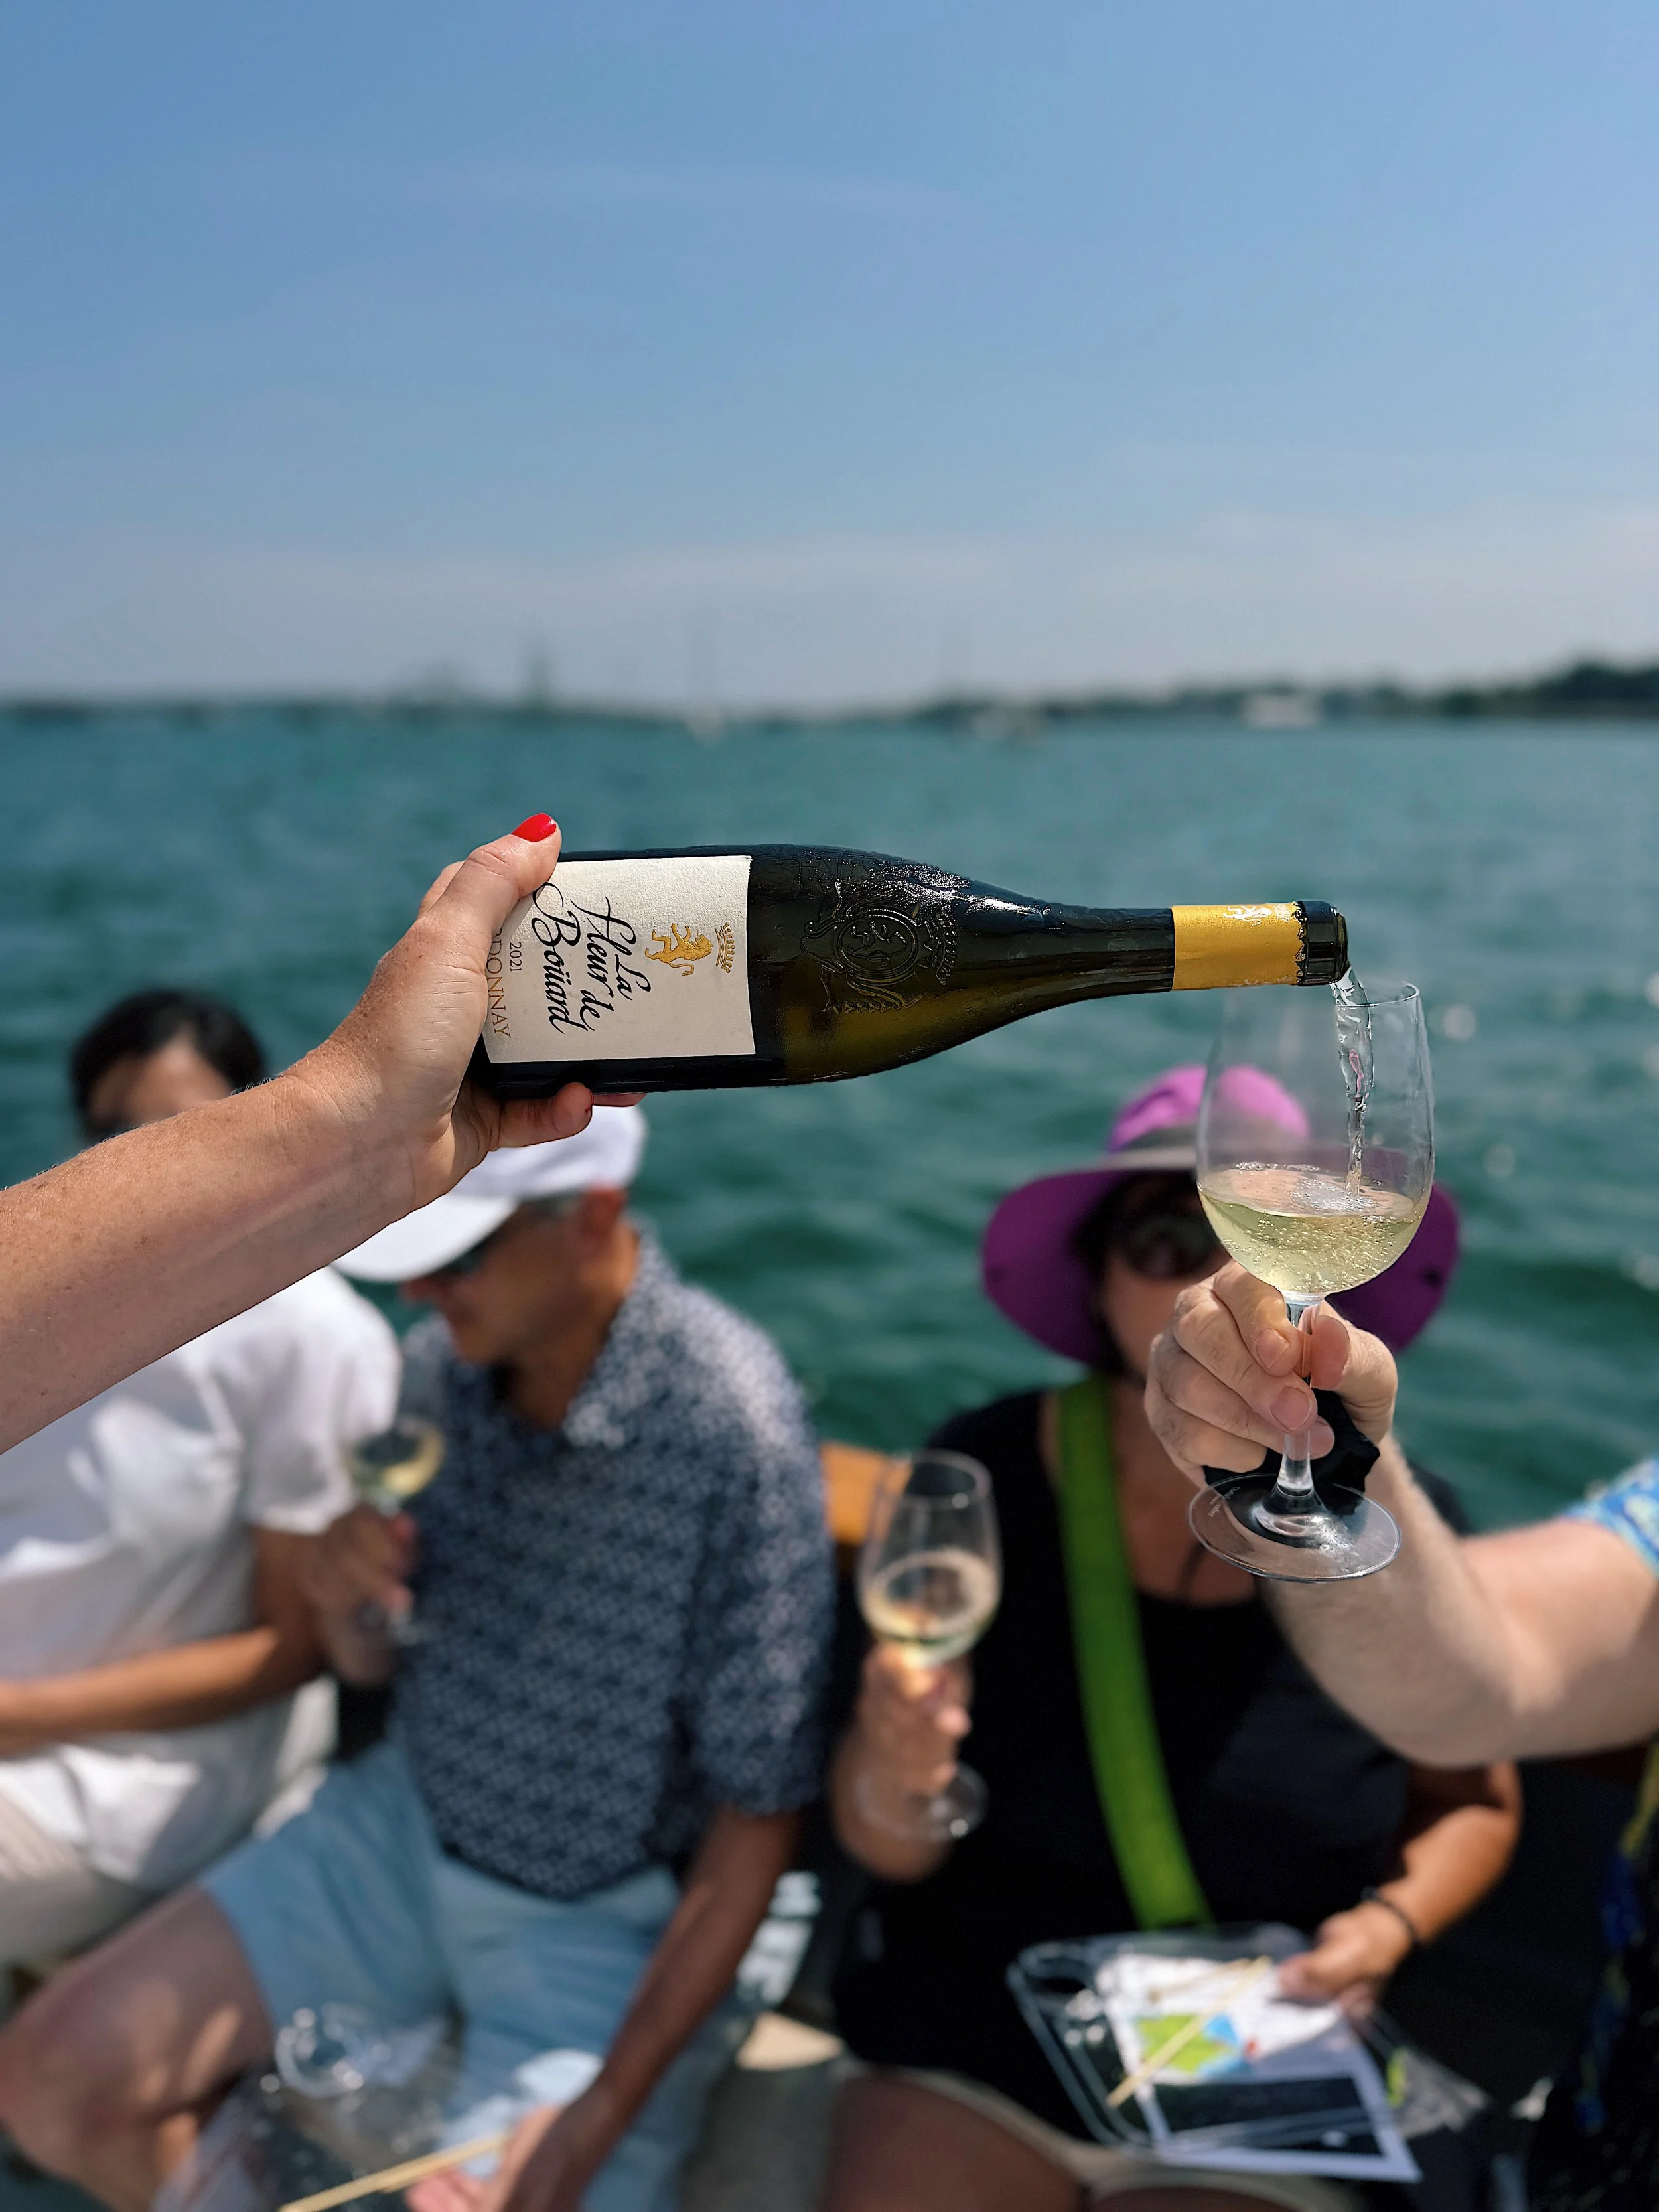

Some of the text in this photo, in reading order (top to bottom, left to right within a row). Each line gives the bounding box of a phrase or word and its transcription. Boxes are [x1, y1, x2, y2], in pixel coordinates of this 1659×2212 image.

[509, 942, 522, 972] 2021
[532, 881, 589, 1034] Boüard
[615, 954, 651, 1001] La
[579, 989, 614, 1031] de
